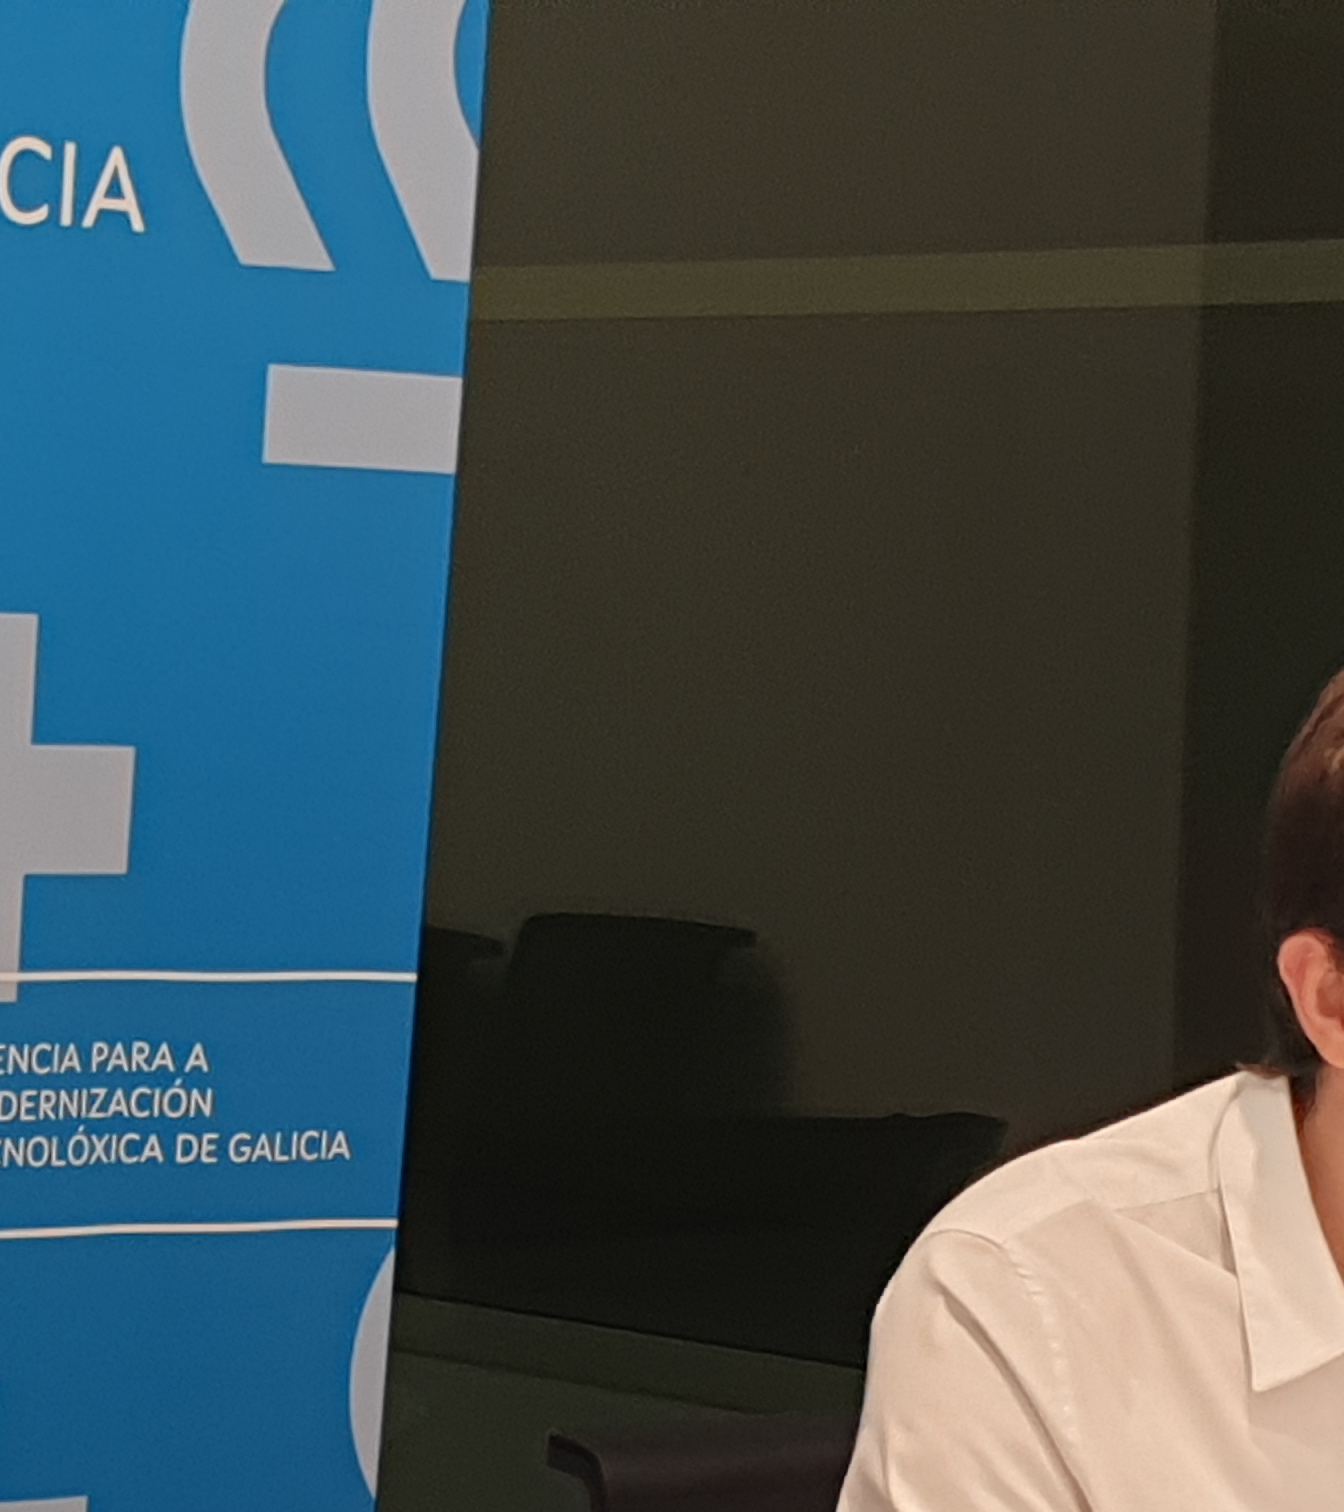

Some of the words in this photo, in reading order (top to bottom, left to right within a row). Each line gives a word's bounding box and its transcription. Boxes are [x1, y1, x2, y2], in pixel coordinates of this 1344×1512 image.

[91, 1041, 175, 1073] PARA
[184, 1042, 209, 1073] A
[175, 1133, 220, 1164] DE
[228, 1129, 351, 1163] GALICIA
